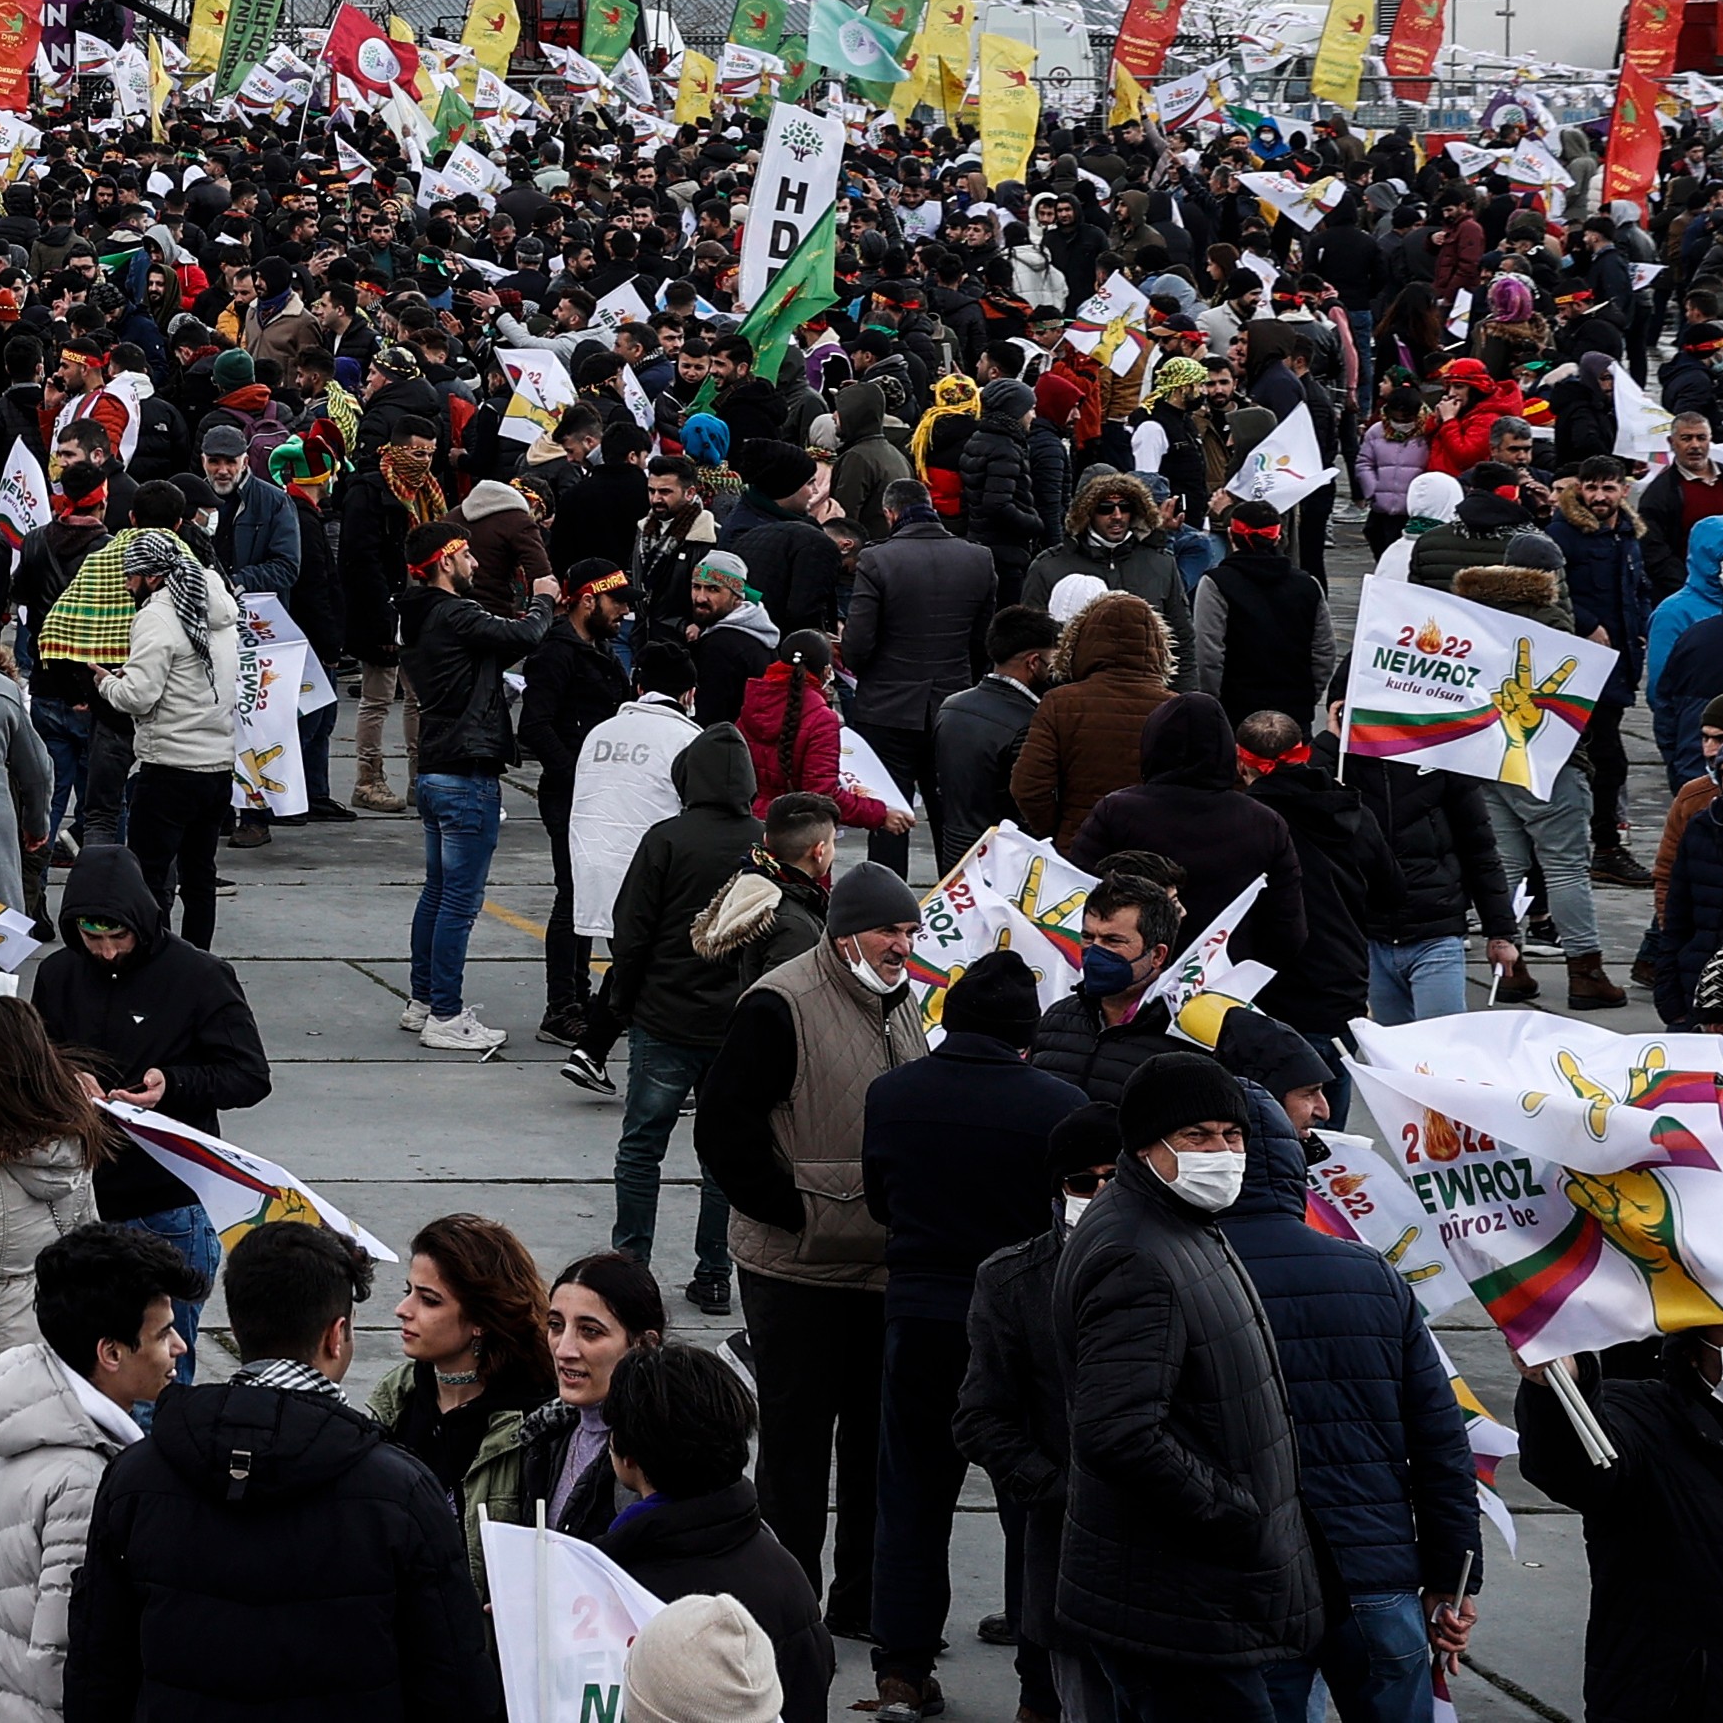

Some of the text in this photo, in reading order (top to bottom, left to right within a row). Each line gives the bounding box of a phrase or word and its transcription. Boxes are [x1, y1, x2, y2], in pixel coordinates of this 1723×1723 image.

[238, 649, 257, 729] NEWROZ
[1371, 646, 1482, 689] NEWROZ
[1385, 677, 1466, 704] kutlu olsun
[593, 739, 650, 767] D&G
[1438, 1202, 1540, 1250] pîroz be
